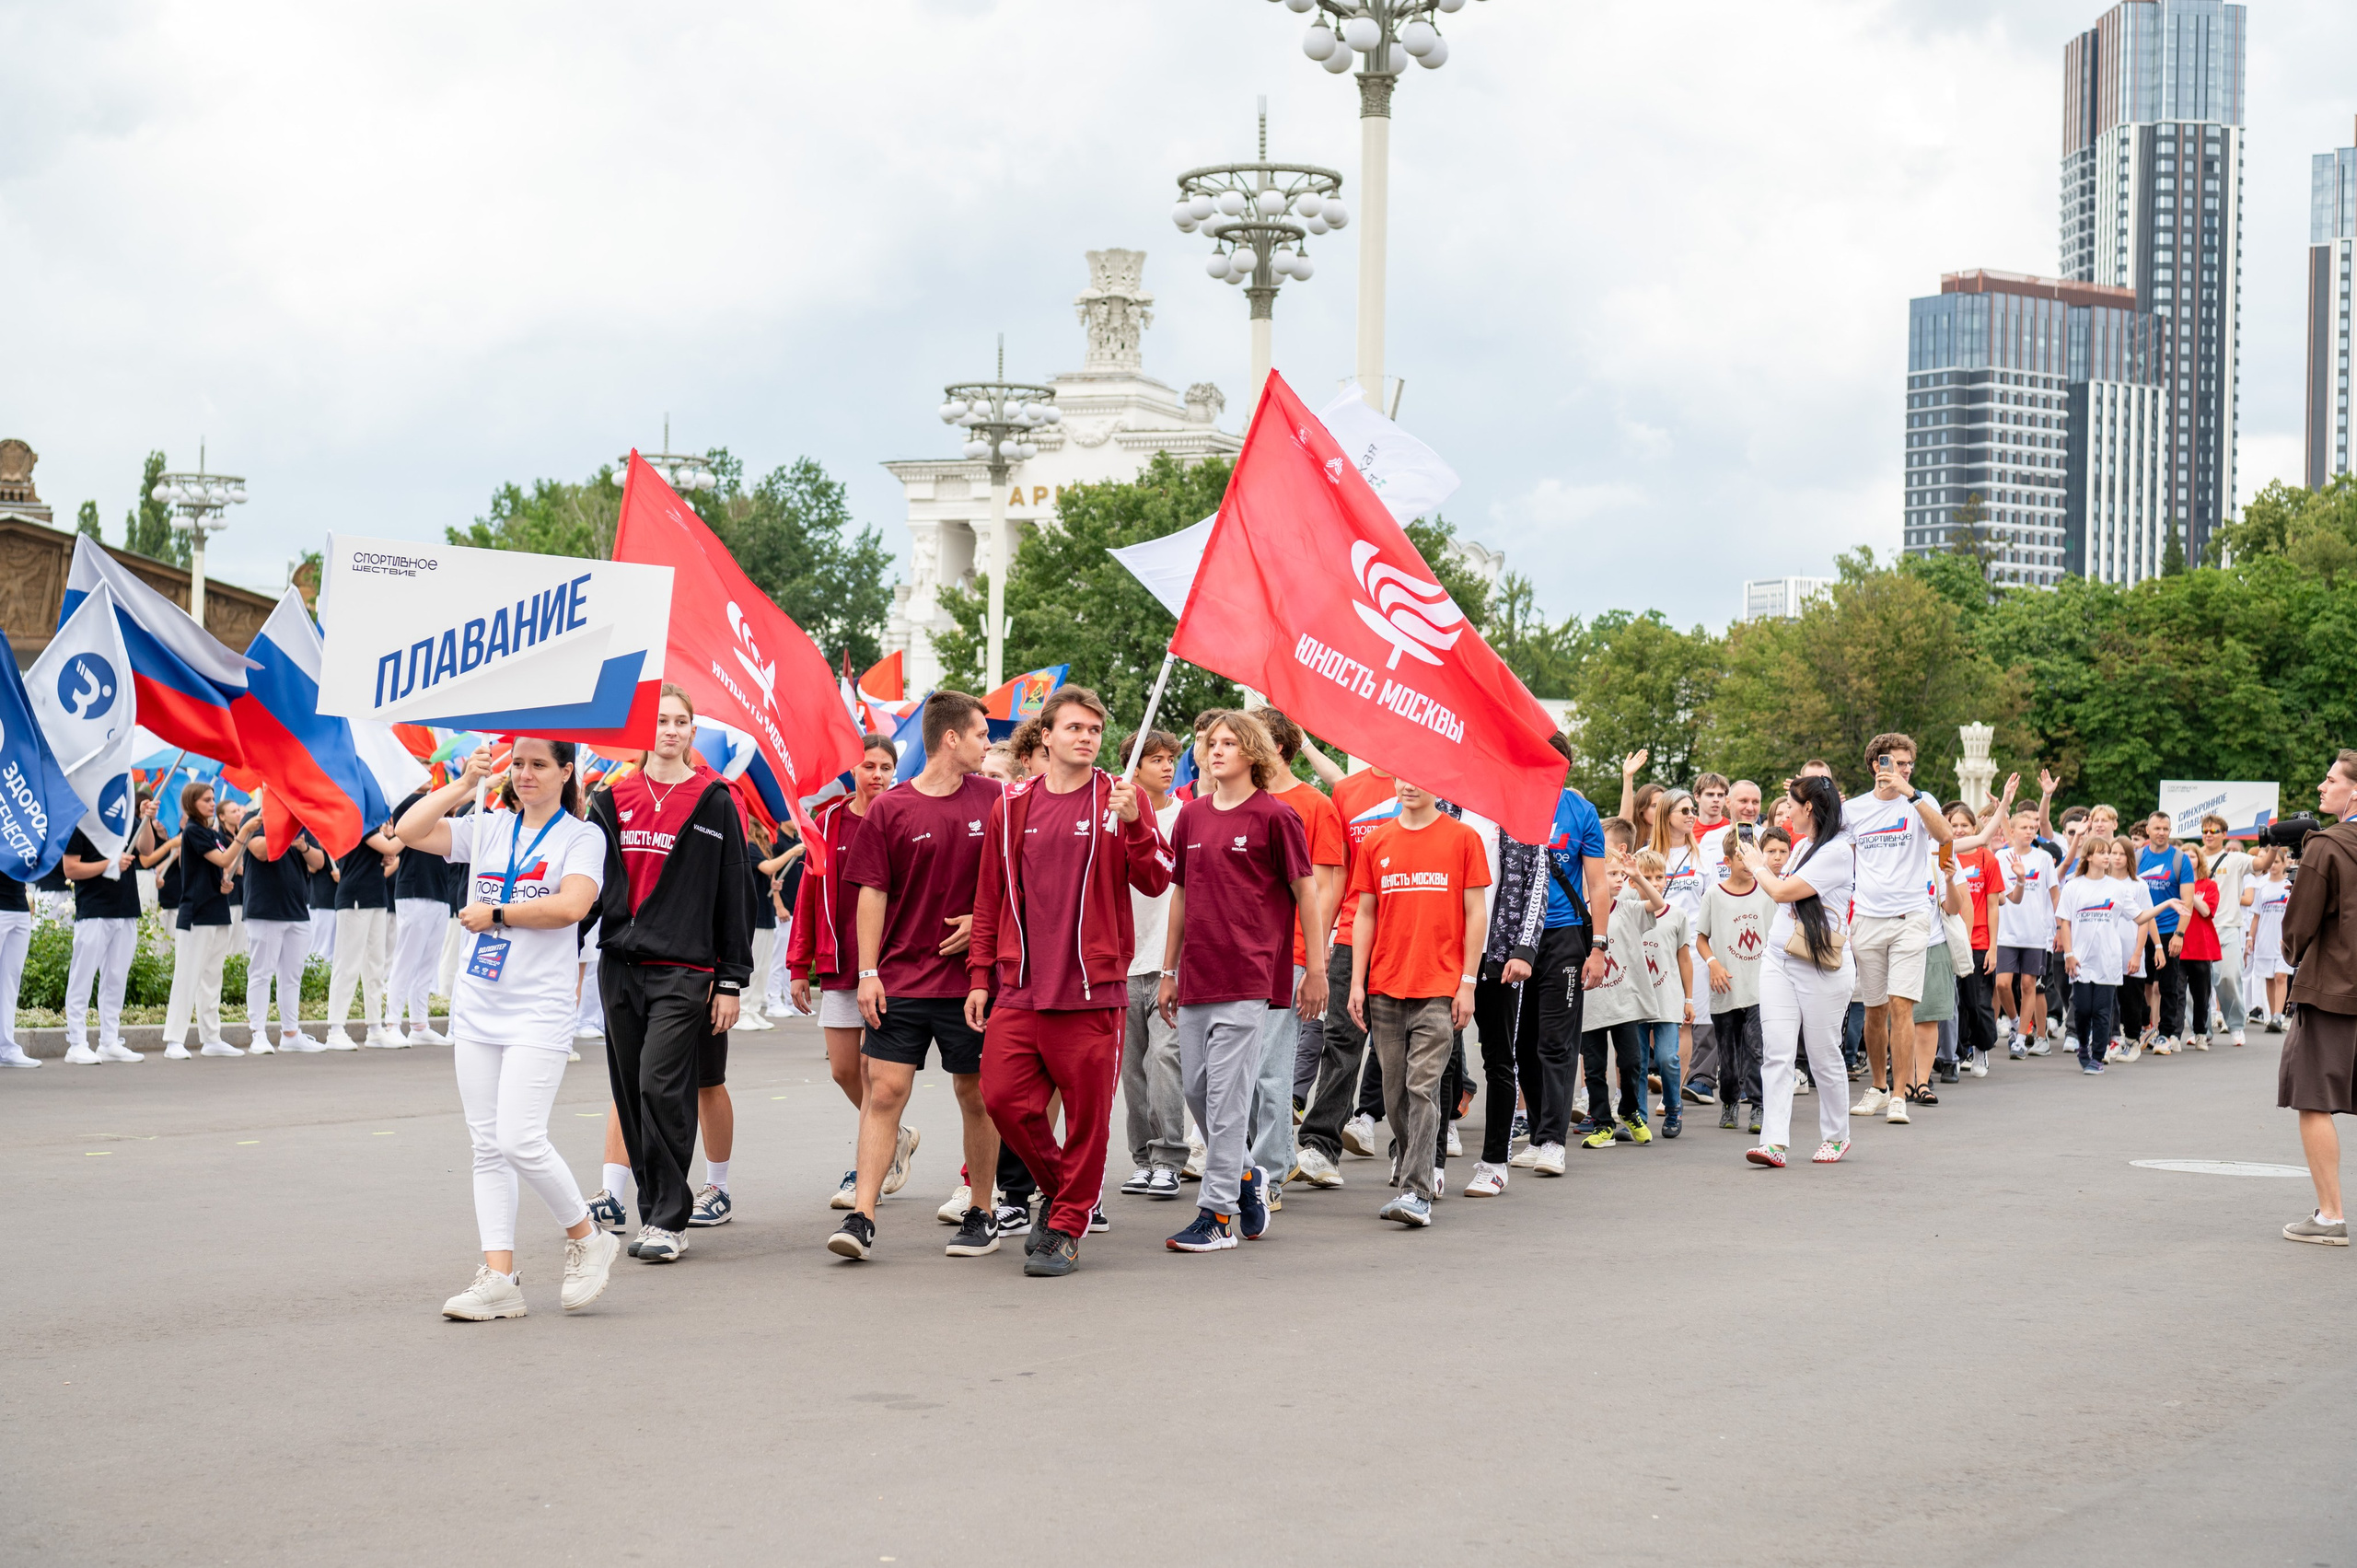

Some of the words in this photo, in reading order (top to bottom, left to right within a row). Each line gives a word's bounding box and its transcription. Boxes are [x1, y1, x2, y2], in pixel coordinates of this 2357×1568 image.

[352, 564, 417, 577] ШЕСТВИЕ
[374, 572, 592, 710] ПЛАВАНИЕ
[1294, 632, 1377, 700] ЮНОСТЬ
[1376, 678, 1466, 745] МОСКВЫ
[2177, 792, 2227, 822] СИНХРОННОЕ
[2177, 807, 2219, 834] ПЛАВИЕ
[651, 831, 676, 850] МОС
[1411, 871, 1448, 886] МОСКВЫ
[1733, 913, 1759, 923] МГФСО
[1726, 945, 1763, 961] МОСКОМСП
[1598, 965, 1628, 989] ОМСПОРТА
